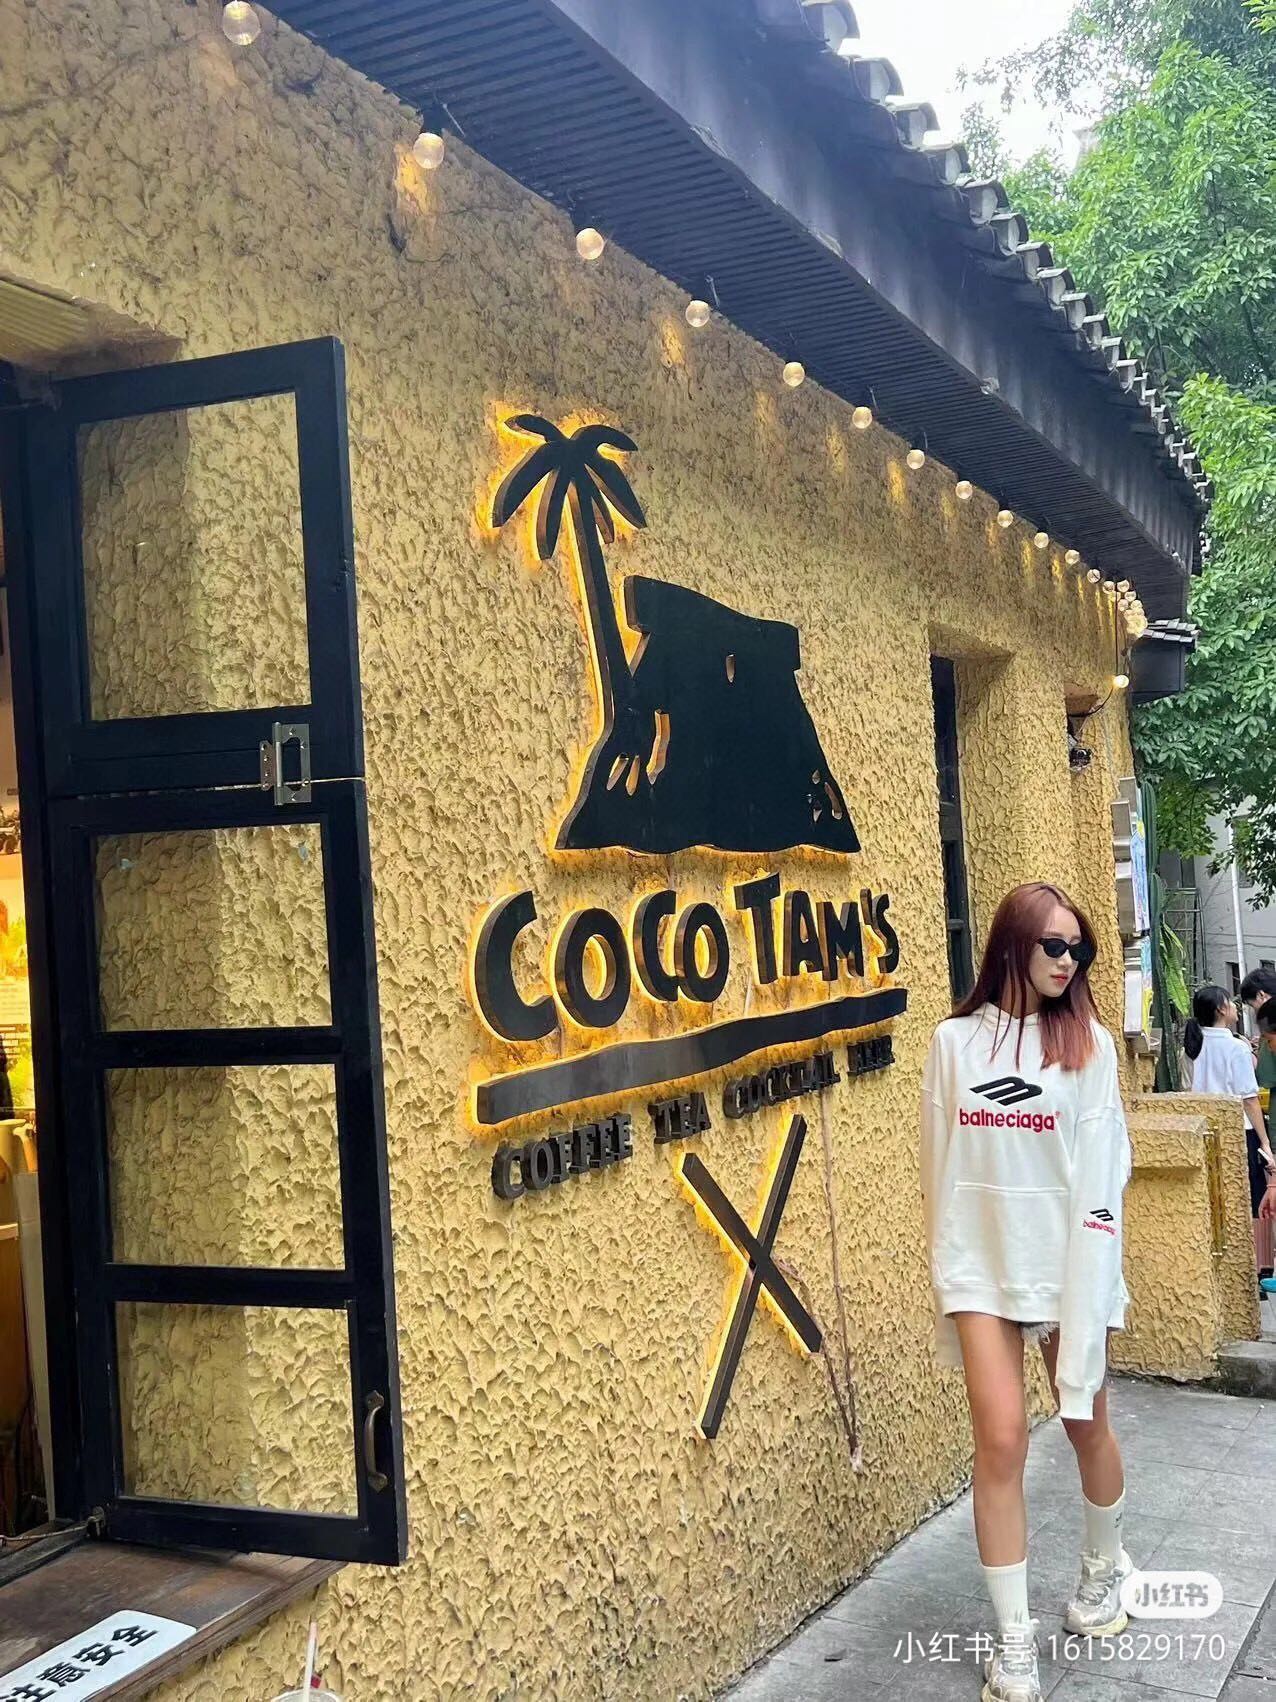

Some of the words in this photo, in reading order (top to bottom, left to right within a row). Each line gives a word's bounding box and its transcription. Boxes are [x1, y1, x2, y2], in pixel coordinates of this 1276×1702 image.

[733, 872, 900, 985] TAM'S
[491, 1112, 633, 1200] COFFEE
[648, 1092, 712, 1144] TEA
[723, 1051, 841, 1119] COCKTAIL
